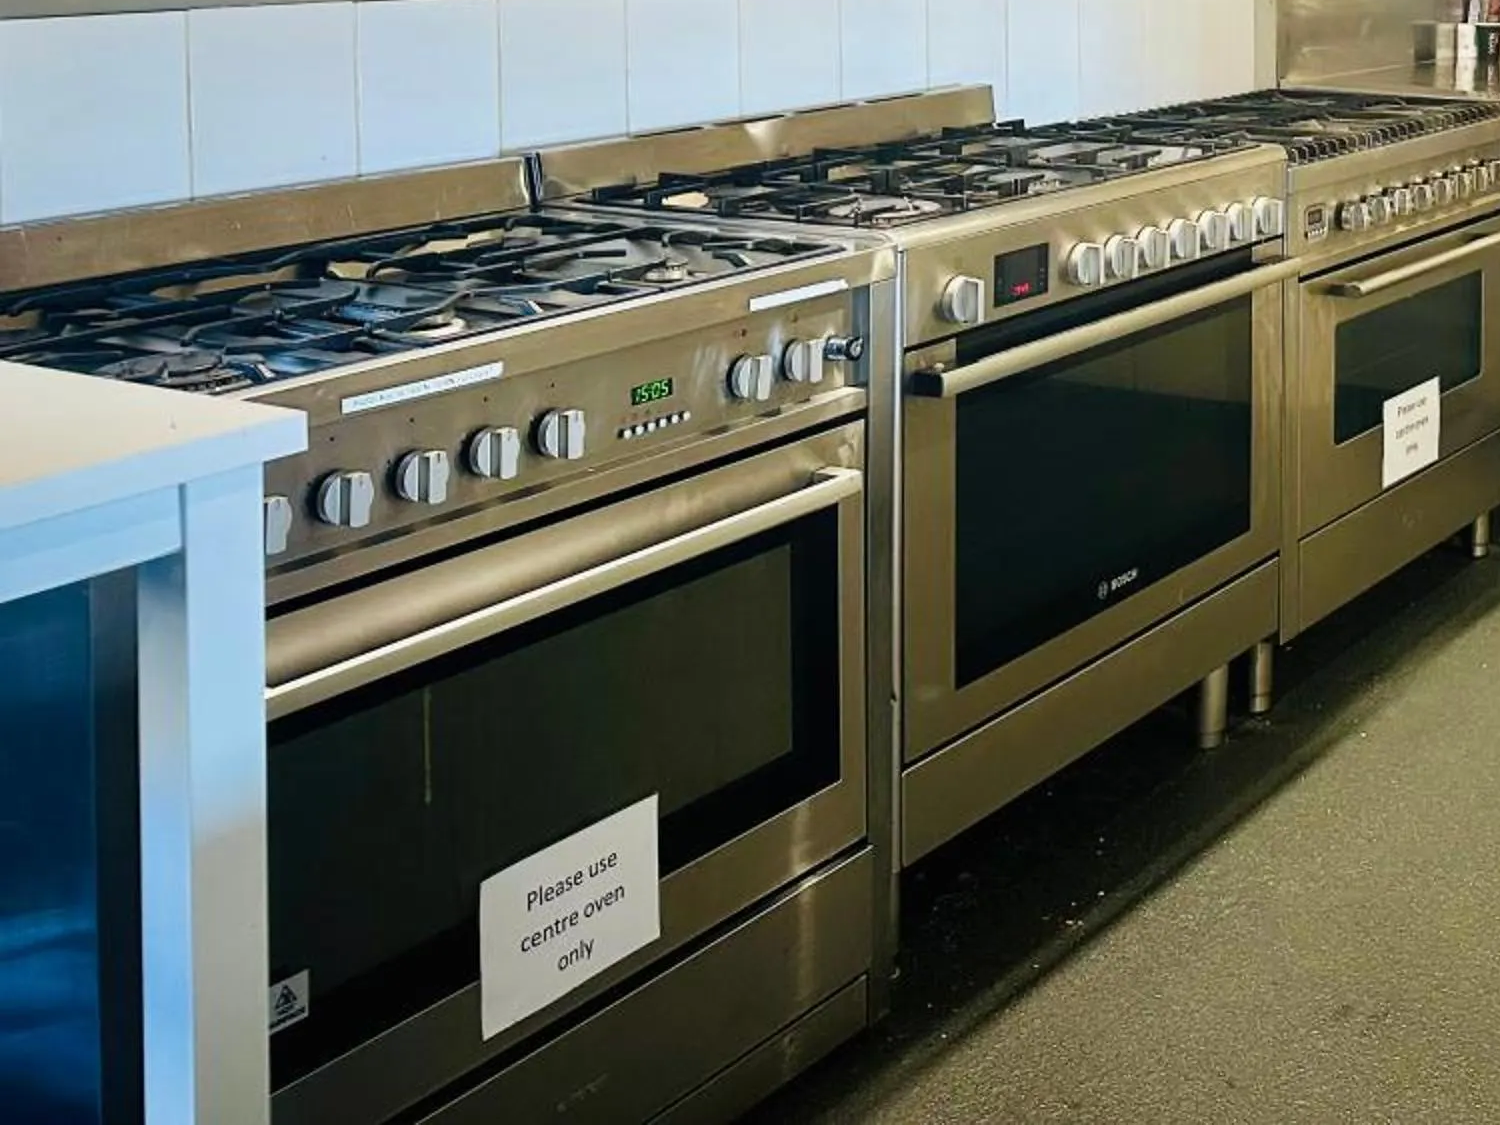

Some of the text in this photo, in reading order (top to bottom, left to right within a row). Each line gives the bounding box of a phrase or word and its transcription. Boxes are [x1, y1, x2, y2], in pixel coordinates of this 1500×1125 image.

[1111, 567, 1138, 591] BOSCH
[526, 852, 617, 912] Please use
[520, 885, 625, 953] centre oven
[557, 938, 594, 971] only
